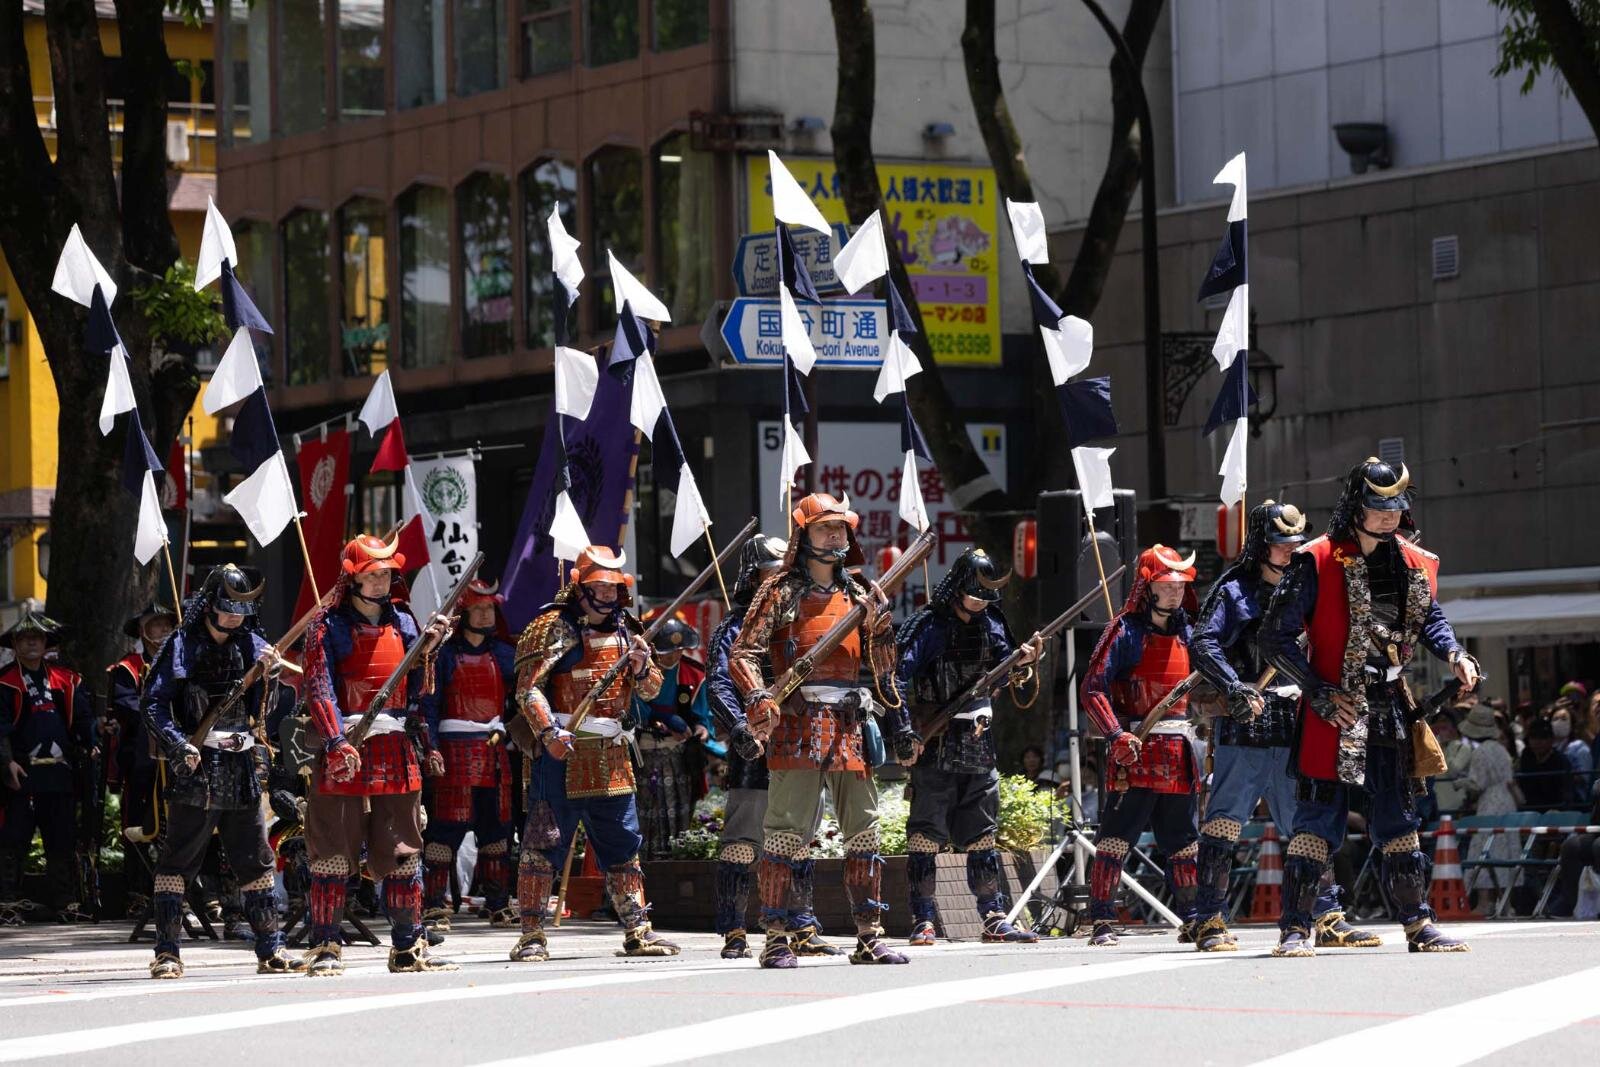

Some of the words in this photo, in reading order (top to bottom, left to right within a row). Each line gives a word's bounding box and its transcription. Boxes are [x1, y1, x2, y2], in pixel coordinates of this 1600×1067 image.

[754, 236, 831, 273] 定寺通
[808, 267, 834, 283] venue
[758, 309, 878, 340] 国分町通
[844, 340, 880, 357] Avenue
[432, 519, 469, 600] 仙台
